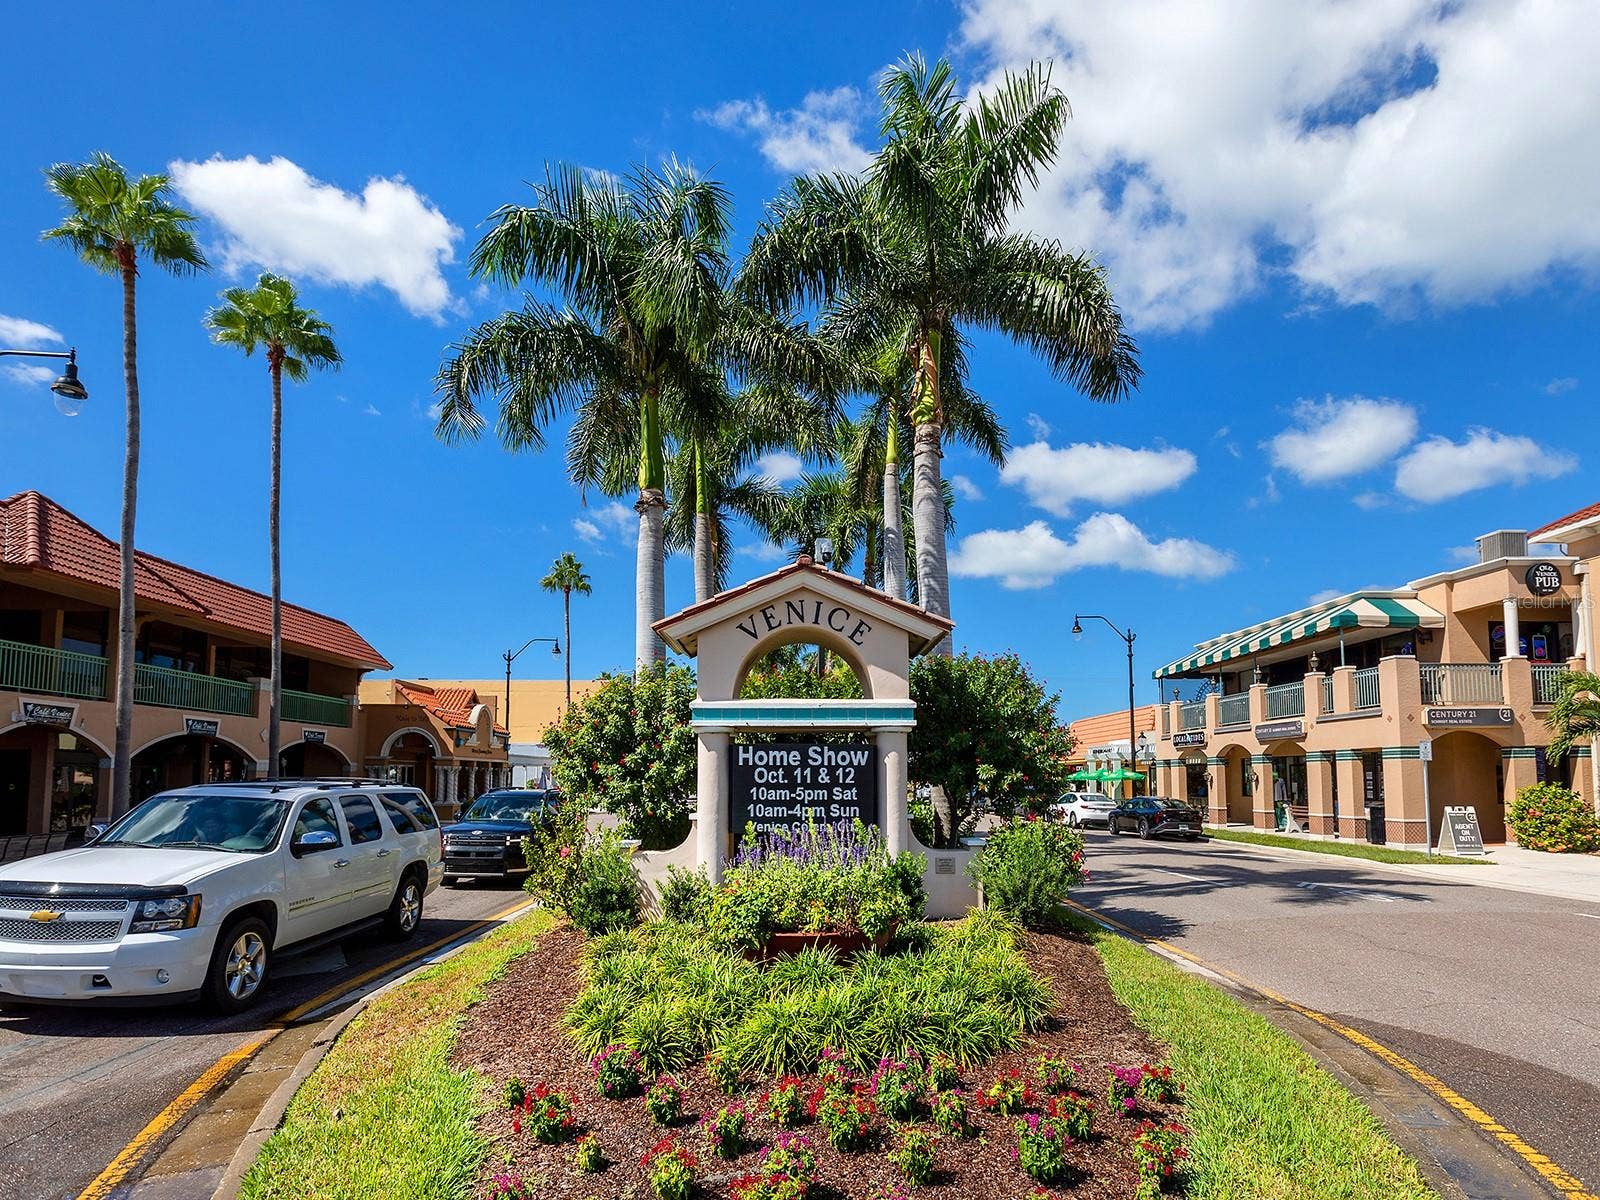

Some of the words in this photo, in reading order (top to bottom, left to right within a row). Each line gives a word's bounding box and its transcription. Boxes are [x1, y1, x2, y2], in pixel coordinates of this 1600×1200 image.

[1535, 577, 1560, 588] PUB
[736, 600, 872, 646] VENICE
[1430, 710, 1468, 718] CENTURY
[1469, 710, 1477, 718] 21
[1502, 709, 1511, 718] 21
[738, 746, 801, 766] Home
[808, 746, 869, 766] Show
[754, 767, 788, 784] Oct.
[794, 767, 811, 784] 11
[818, 767, 830, 784] &
[835, 767, 855, 784] 12
[750, 787, 828, 804] 10am-5pm
[832, 787, 858, 801] Sat
[747, 803, 825, 821] 10am-4pm
[830, 803, 860, 818] Sun
